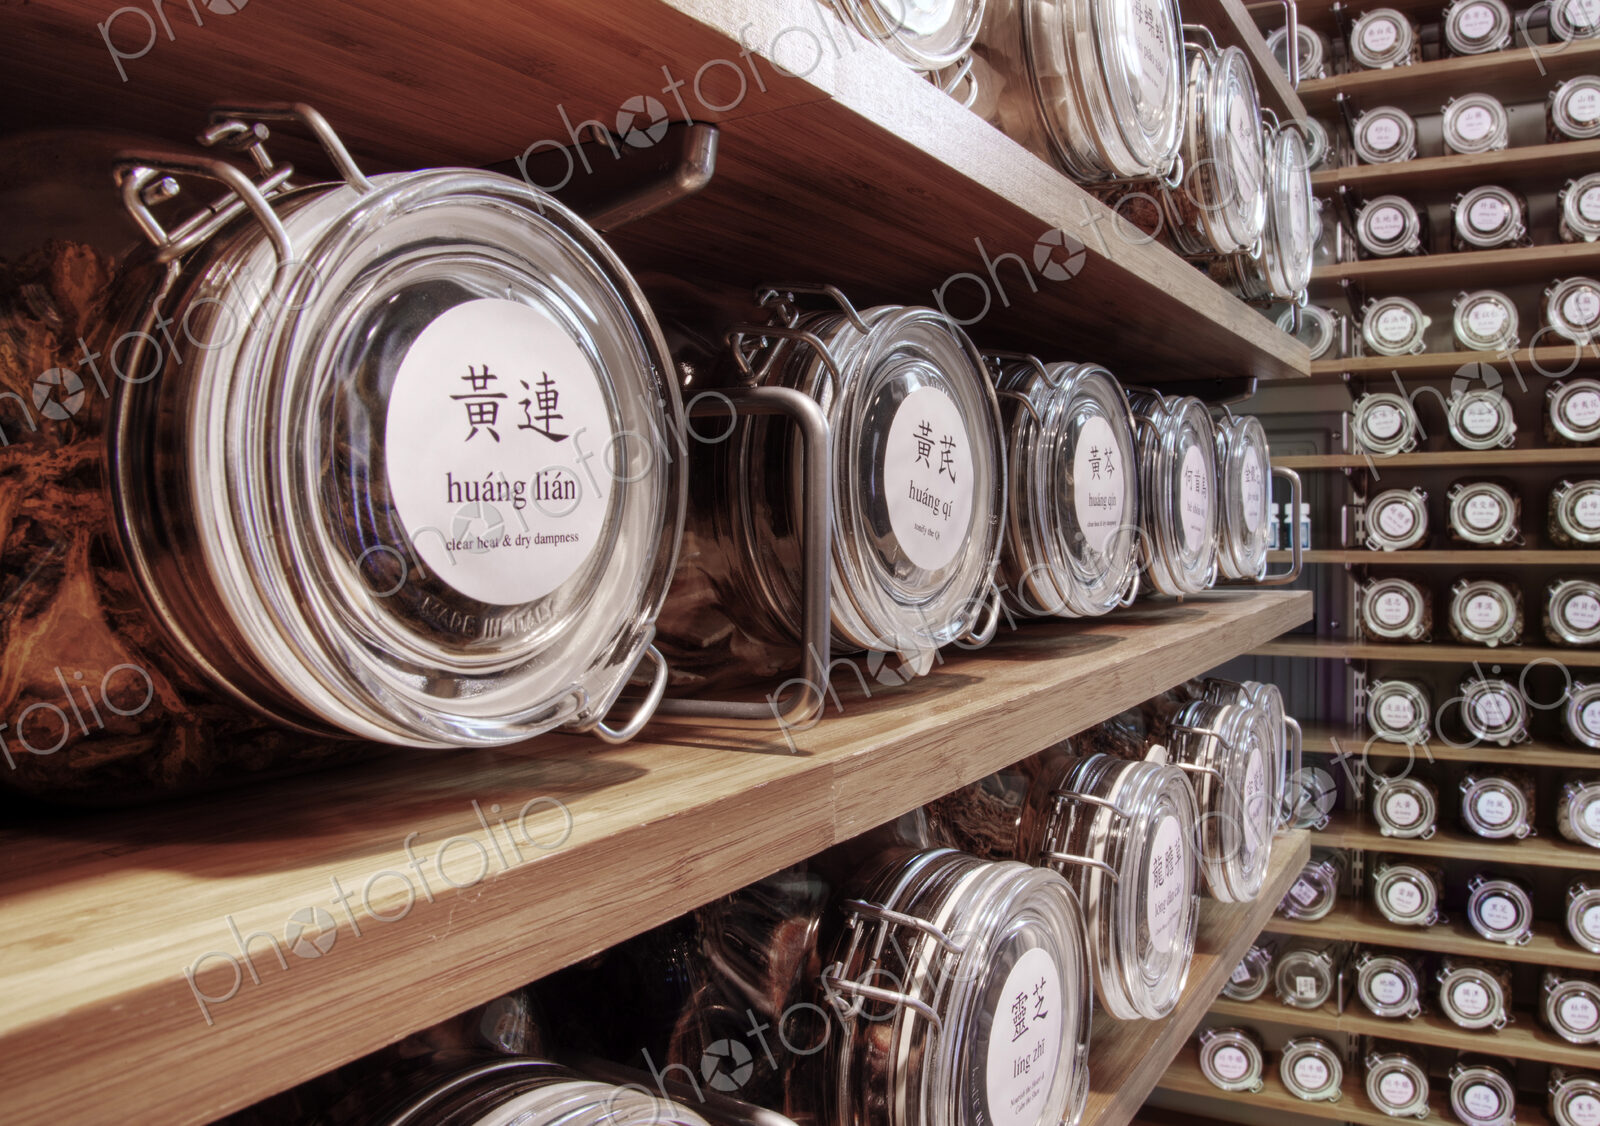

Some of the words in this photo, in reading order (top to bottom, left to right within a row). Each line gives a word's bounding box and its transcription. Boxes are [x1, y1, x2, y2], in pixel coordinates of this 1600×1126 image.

[449, 364, 569, 443] 黃連
[446, 471, 527, 510] huáng
[535, 471, 576, 501] lián
[908, 480, 941, 516] huáng
[942, 500, 952, 521] qí
[446, 538, 474, 551] clear
[476, 536, 500, 550] heat
[502, 535, 512, 547] &
[515, 533, 531, 550] dry
[534, 532, 579, 547] dampness
[1012, 976, 1048, 1043] 靈芝
[1013, 1054, 1031, 1078] líng
[1033, 1038, 1045, 1063] zhī
